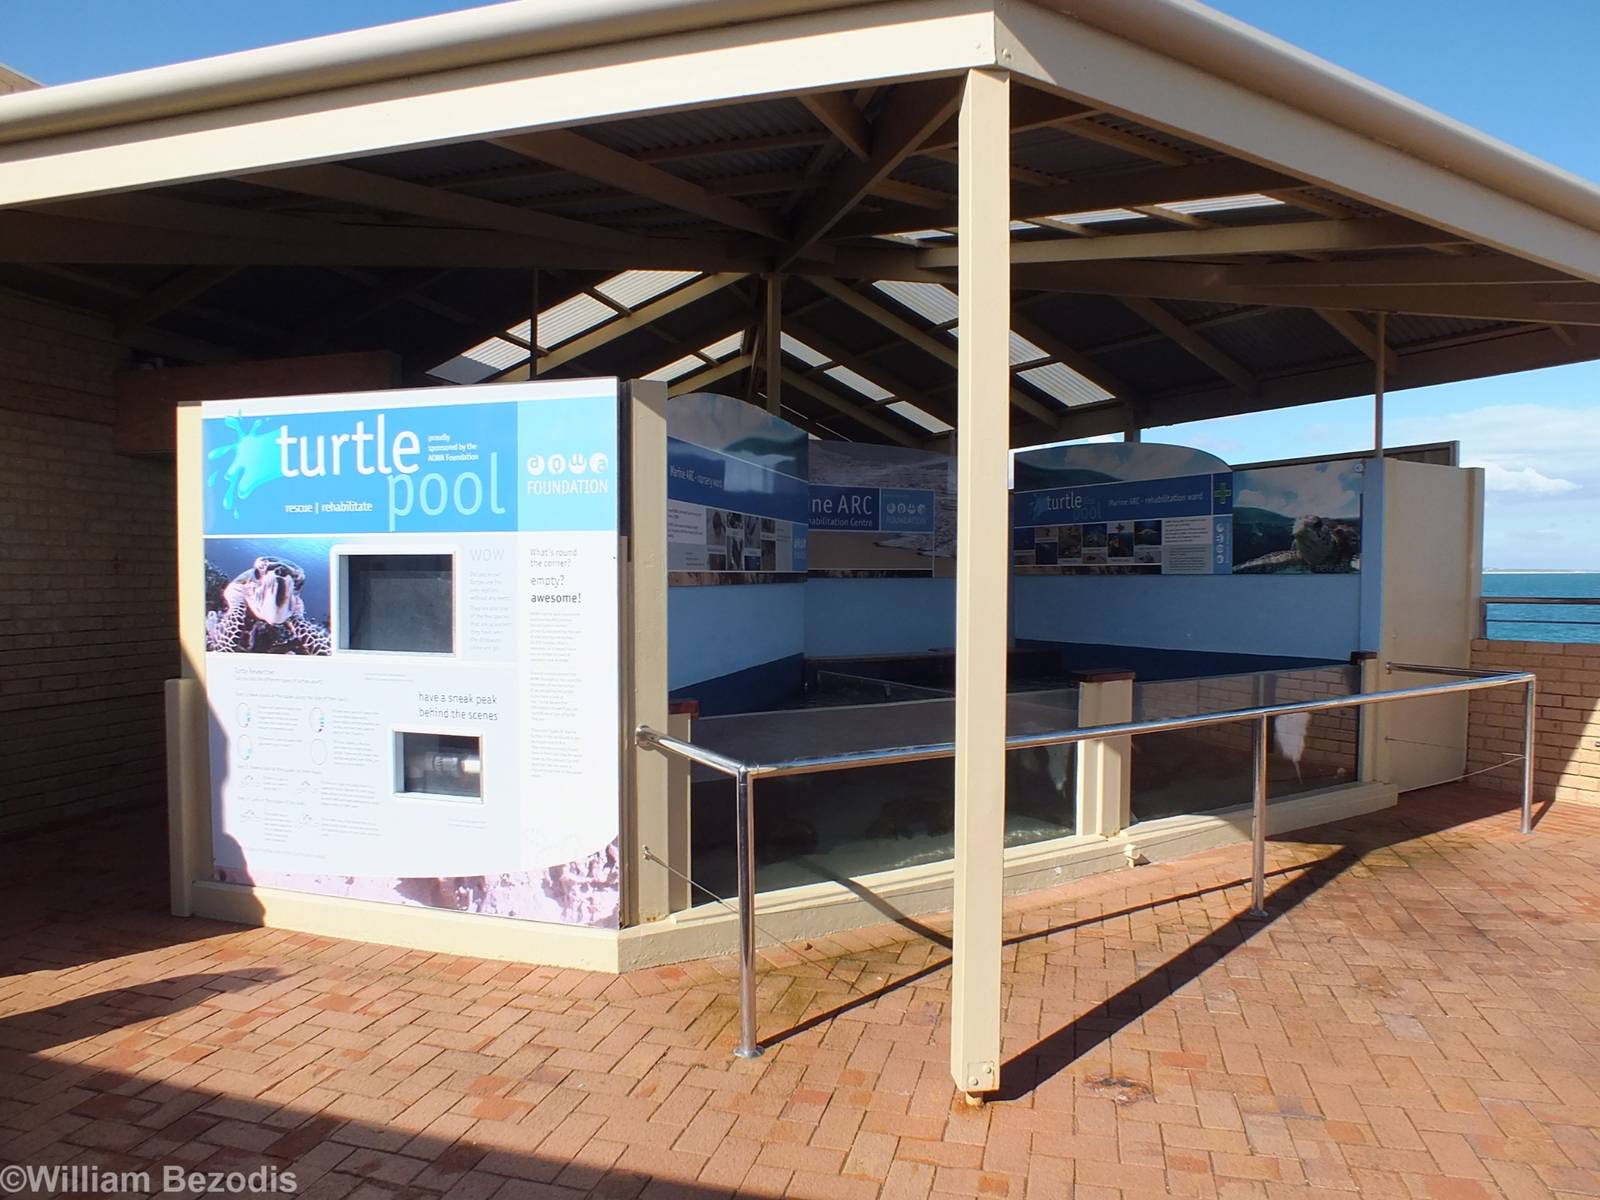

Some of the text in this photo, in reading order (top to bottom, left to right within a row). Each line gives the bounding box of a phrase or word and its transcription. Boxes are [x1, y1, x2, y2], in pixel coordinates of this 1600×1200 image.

[276, 413, 421, 478] turtle
[446, 453, 480, 462] Foundation
[387, 452, 506, 532] pool
[527, 479, 609, 495] FOUNDATION
[837, 495, 872, 515] ARC
[1047, 491, 1082, 511] turtle
[1145, 494, 1186, 504] rehabilitation
[285, 504, 313, 513] rescue
[321, 500, 373, 513] rehabilitate
[850, 517, 873, 528] Centre
[530, 548, 577, 557] What's round
[530, 559, 572, 568] the corner?
[530, 574, 565, 588] empty?
[531, 592, 582, 604] awesome!
[418, 691, 497, 707] have a sneak peak
[419, 706, 498, 721] behind the scenes
